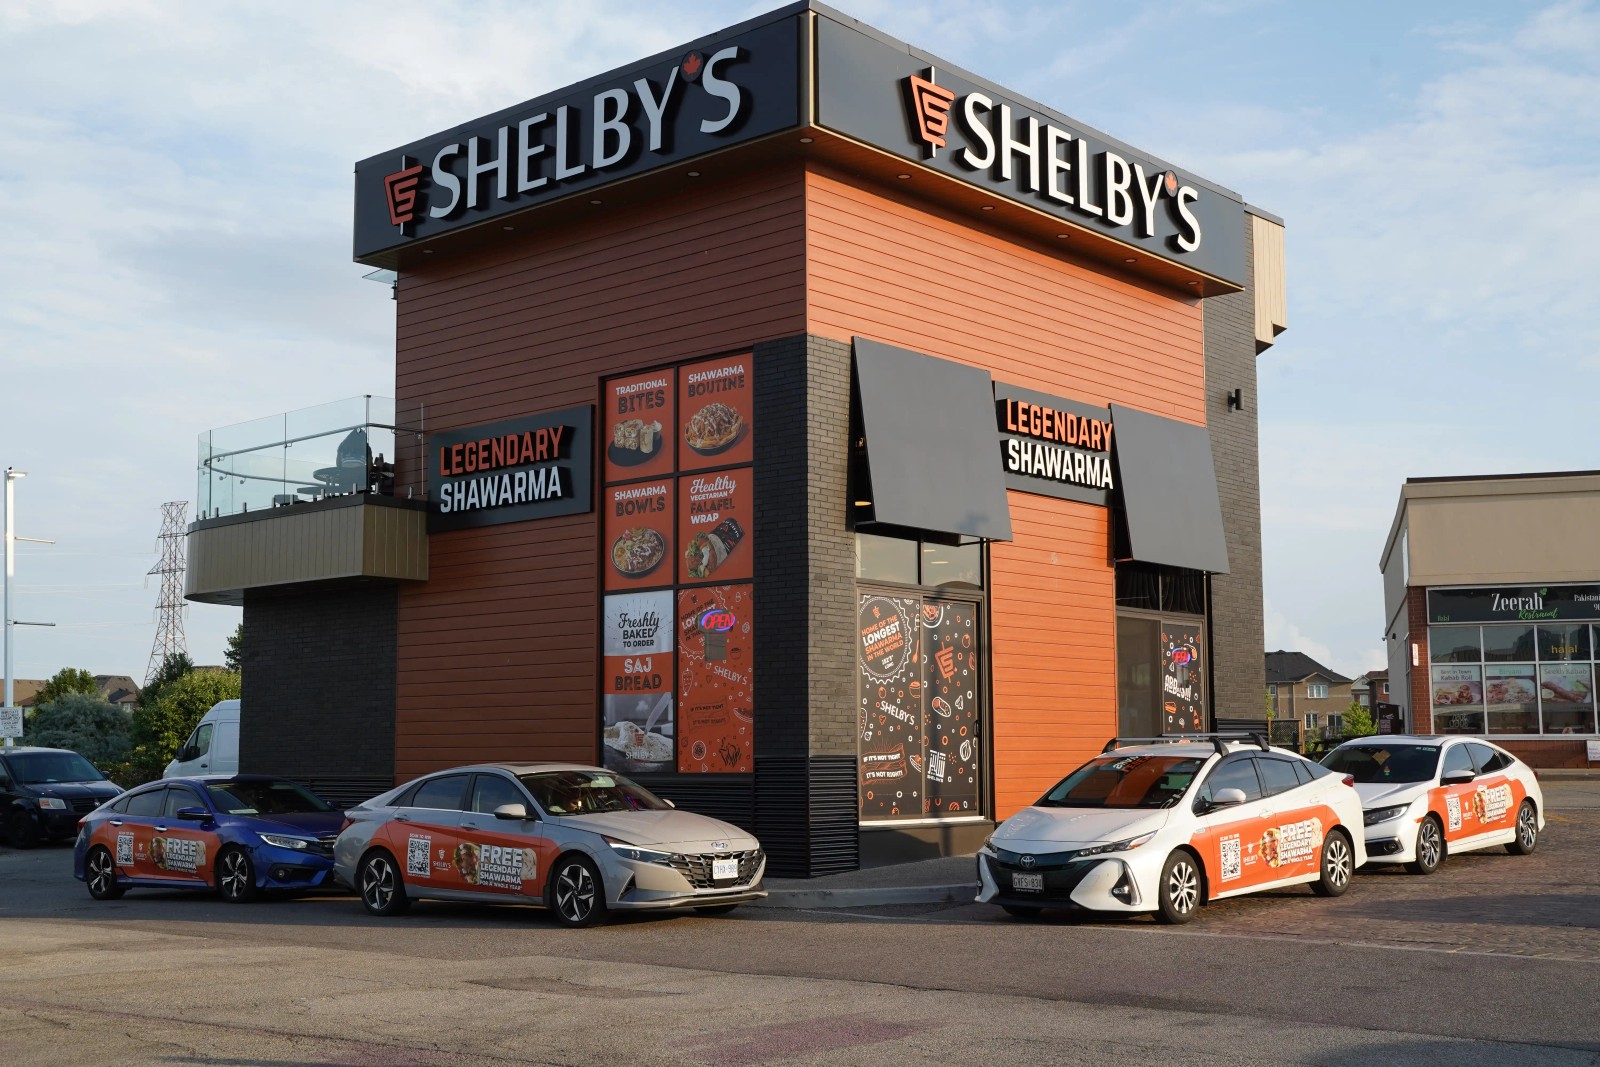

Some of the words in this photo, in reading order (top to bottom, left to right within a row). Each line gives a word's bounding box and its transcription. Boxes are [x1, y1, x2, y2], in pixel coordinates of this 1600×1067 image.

[429, 46, 739, 219] SHELBY'S
[962, 92, 1201, 253] SHELBY'S
[688, 365, 745, 384] SHAWARMA
[616, 378, 668, 396] TRADITIONAL
[618, 389, 665, 415] BITES
[1006, 398, 1113, 452] LEGENDARY
[440, 425, 564, 476] LEGENDARY
[1008, 438, 1114, 490] SHAWARMA
[440, 466, 562, 513] SHAWARMA
[614, 485, 667, 501] SHAWARMA
[690, 475, 737, 495] Healthy
[690, 491, 728, 502] VEGETARIAN
[690, 498, 736, 514] FALAFEL
[616, 496, 666, 517] BOWLS
[690, 512, 719, 525] WRAP
[1491, 592, 1543, 611] Zeerah
[618, 611, 660, 632] Freshly
[703, 613, 735, 630] OPEN
[861, 623, 879, 636] HOME
[878, 619, 887, 628] OF
[887, 614, 898, 623] THE
[622, 628, 655, 640] BAKED
[623, 640, 632, 648] TO
[632, 639, 655, 648] ORDER
[862, 621, 900, 647] LONGEST
[865, 632, 903, 655] SHAWARMA
[866, 653, 874, 662] IN
[873, 648, 885, 658] THE
[884, 640, 904, 653] WORLD
[1551, 645, 1578, 654] halal
[624, 657, 652, 674] SAJ
[615, 673, 663, 691] BREAD
[713, 665, 748, 686] SHELBY'S
[880, 700, 915, 725] SHELBY'S
[1280, 819, 1312, 842] FREE
[166, 837, 197, 856] FREE
[1280, 847, 1313, 860] SHAWARMA
[1281, 839, 1312, 850] LEGENDARY
[480, 844, 523, 867] FREE
[480, 863, 521, 875] LEGENDARY
[480, 871, 522, 885] SHAWARMA
